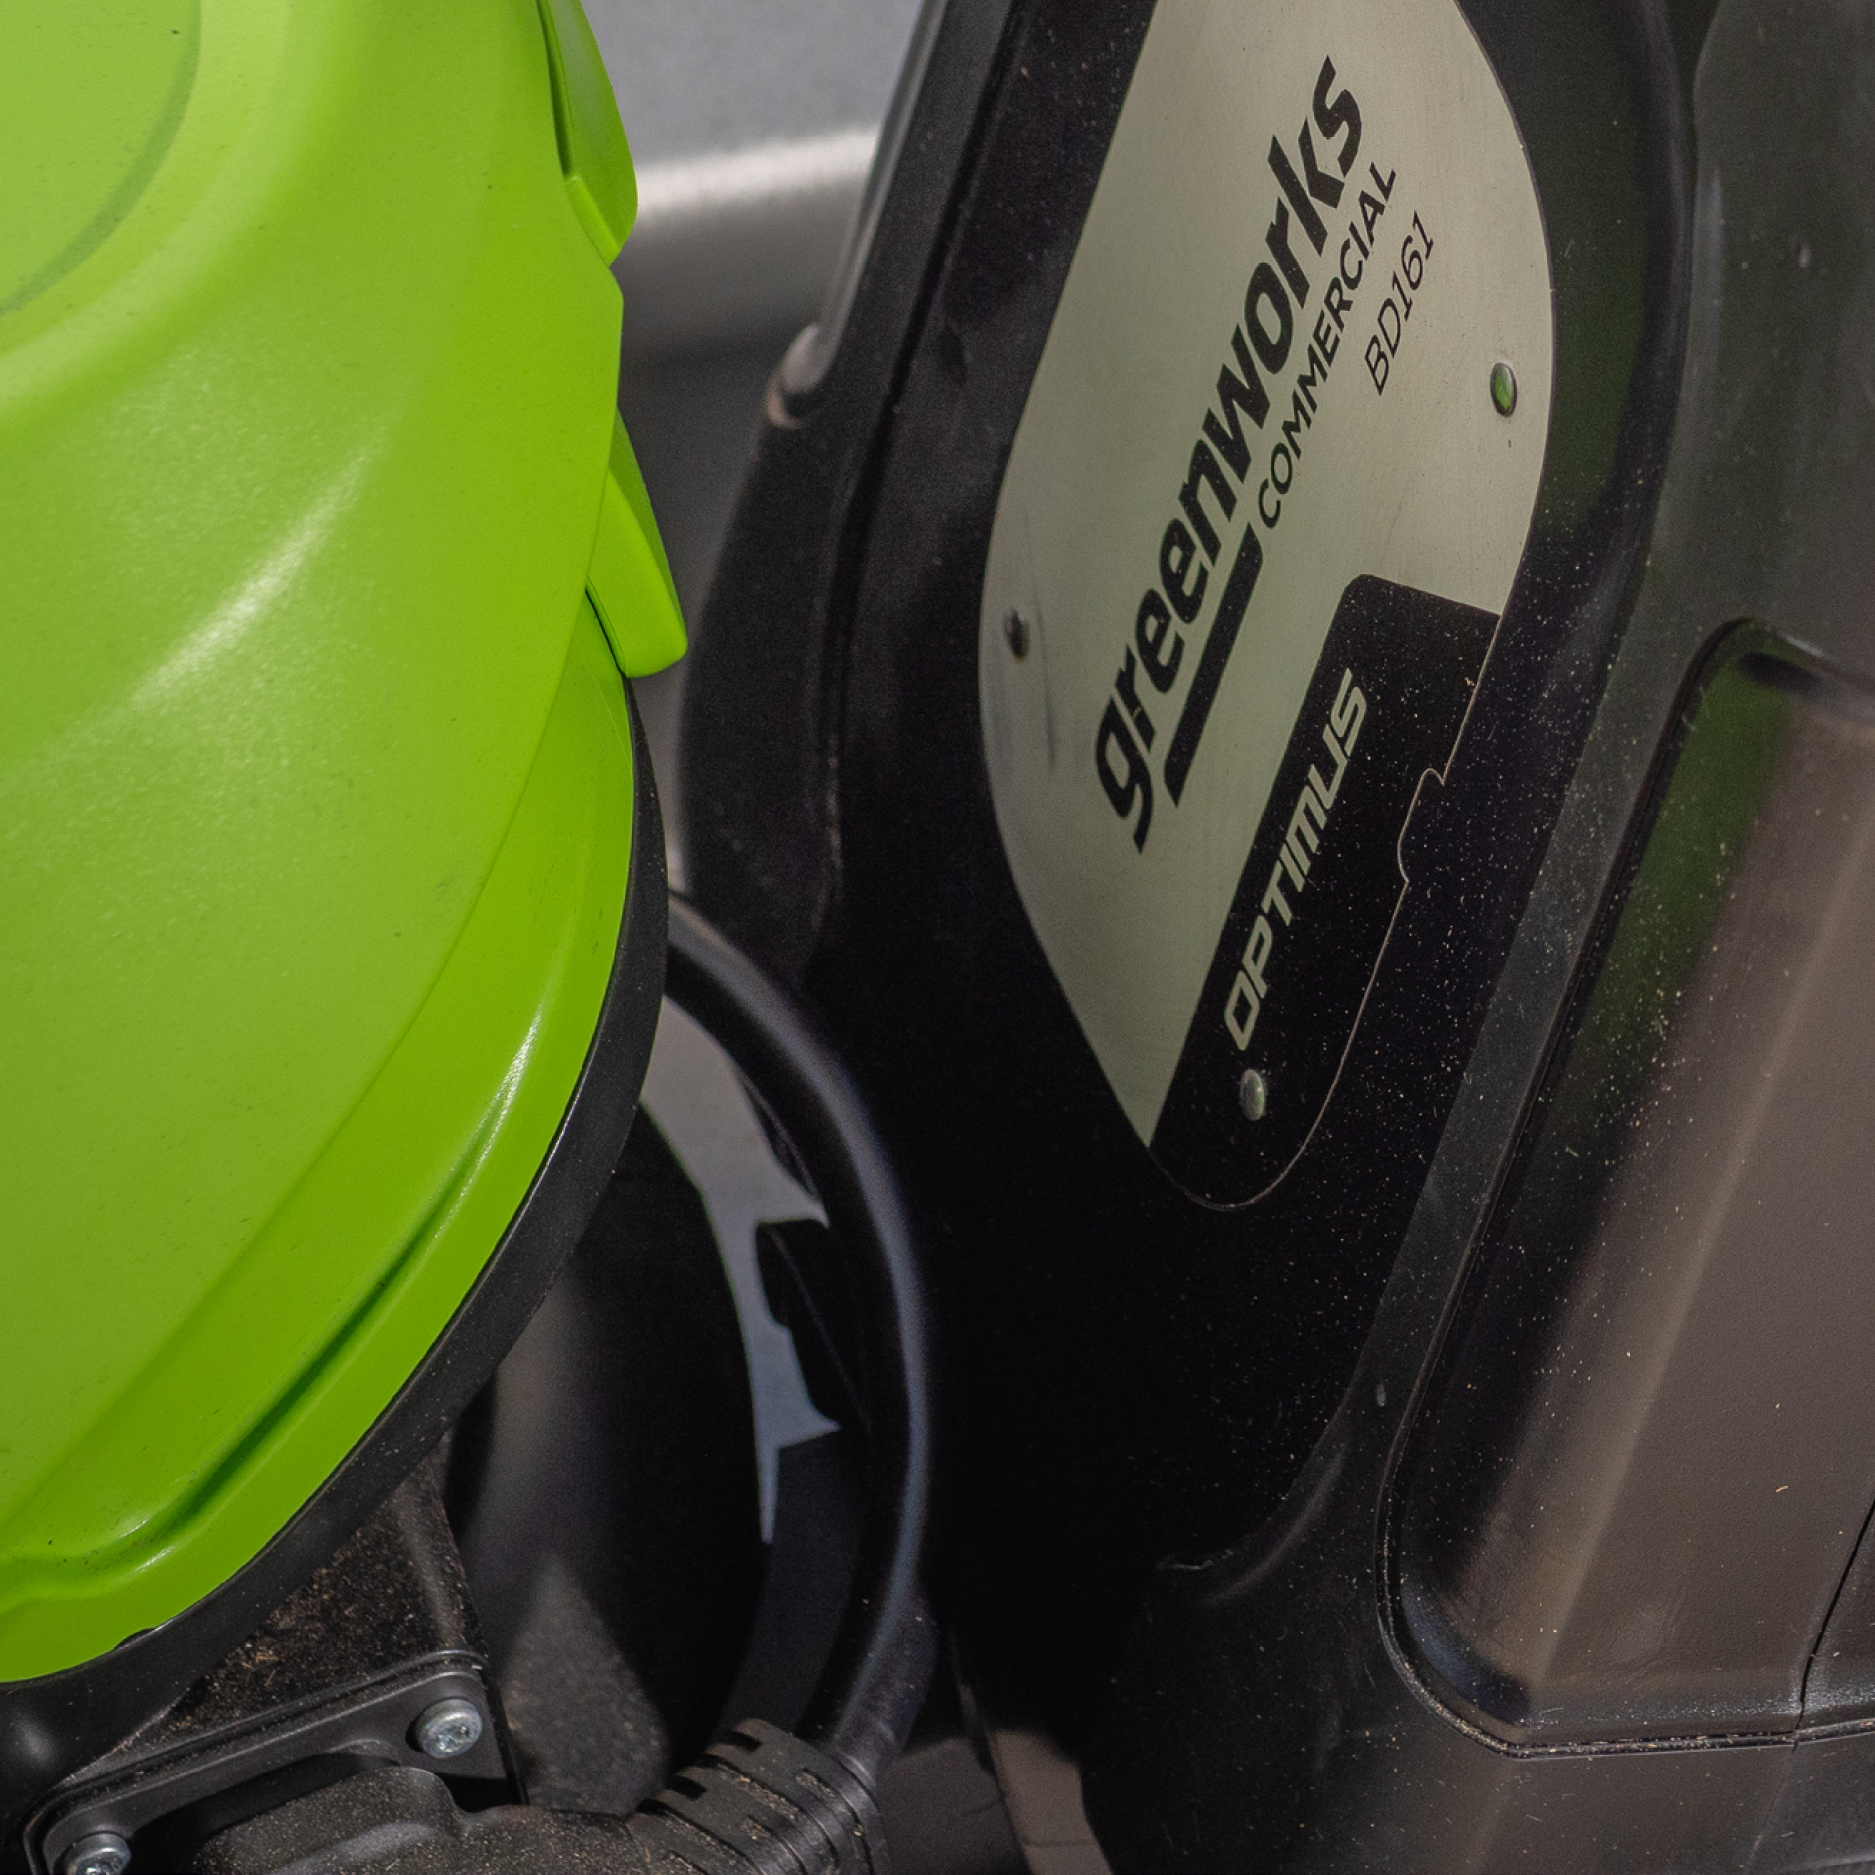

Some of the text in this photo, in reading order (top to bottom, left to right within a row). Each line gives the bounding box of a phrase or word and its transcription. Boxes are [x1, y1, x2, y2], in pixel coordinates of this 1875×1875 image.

[1096, 55, 1361, 854] greenworks
[1258, 162, 1396, 528] COMMERCIAL
[1363, 210, 1434, 396] BD161
[1224, 668, 1367, 1050] OPTIMUS
